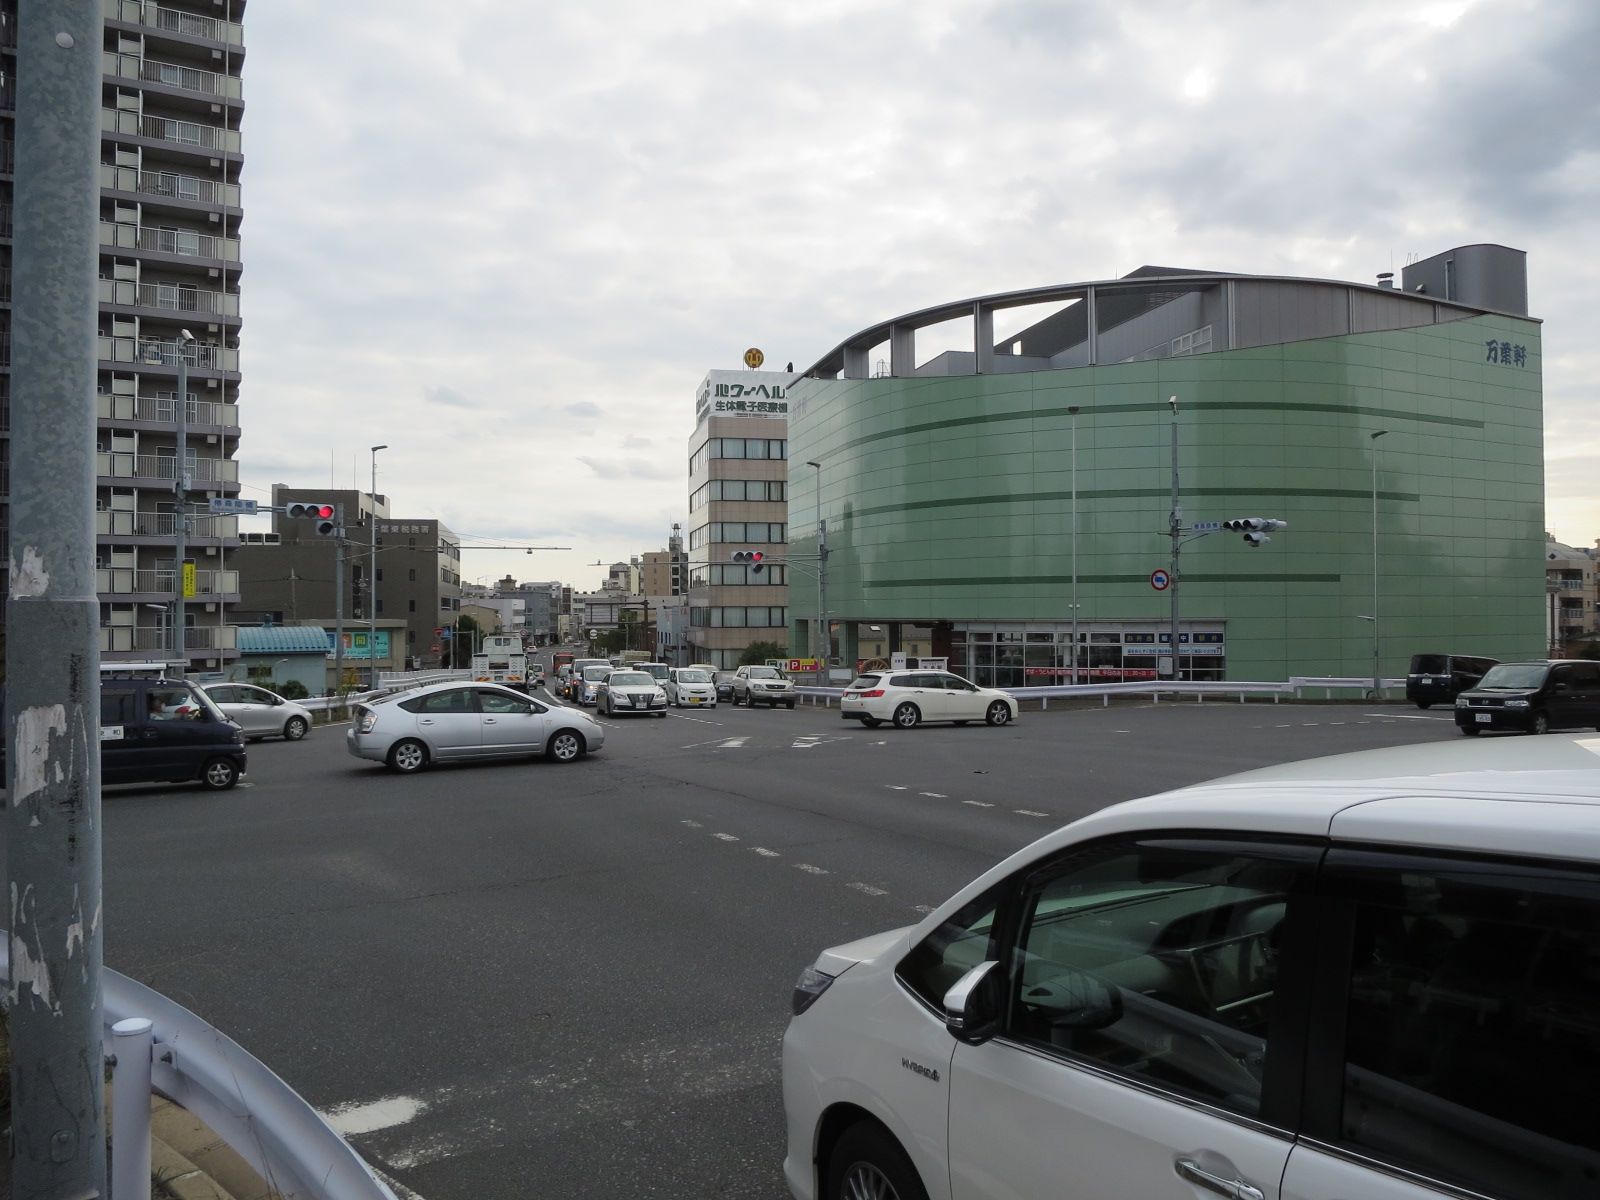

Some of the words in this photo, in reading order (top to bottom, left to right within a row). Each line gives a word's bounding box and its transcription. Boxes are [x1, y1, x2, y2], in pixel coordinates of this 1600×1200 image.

[714, 383, 788, 399] パワーヘル
